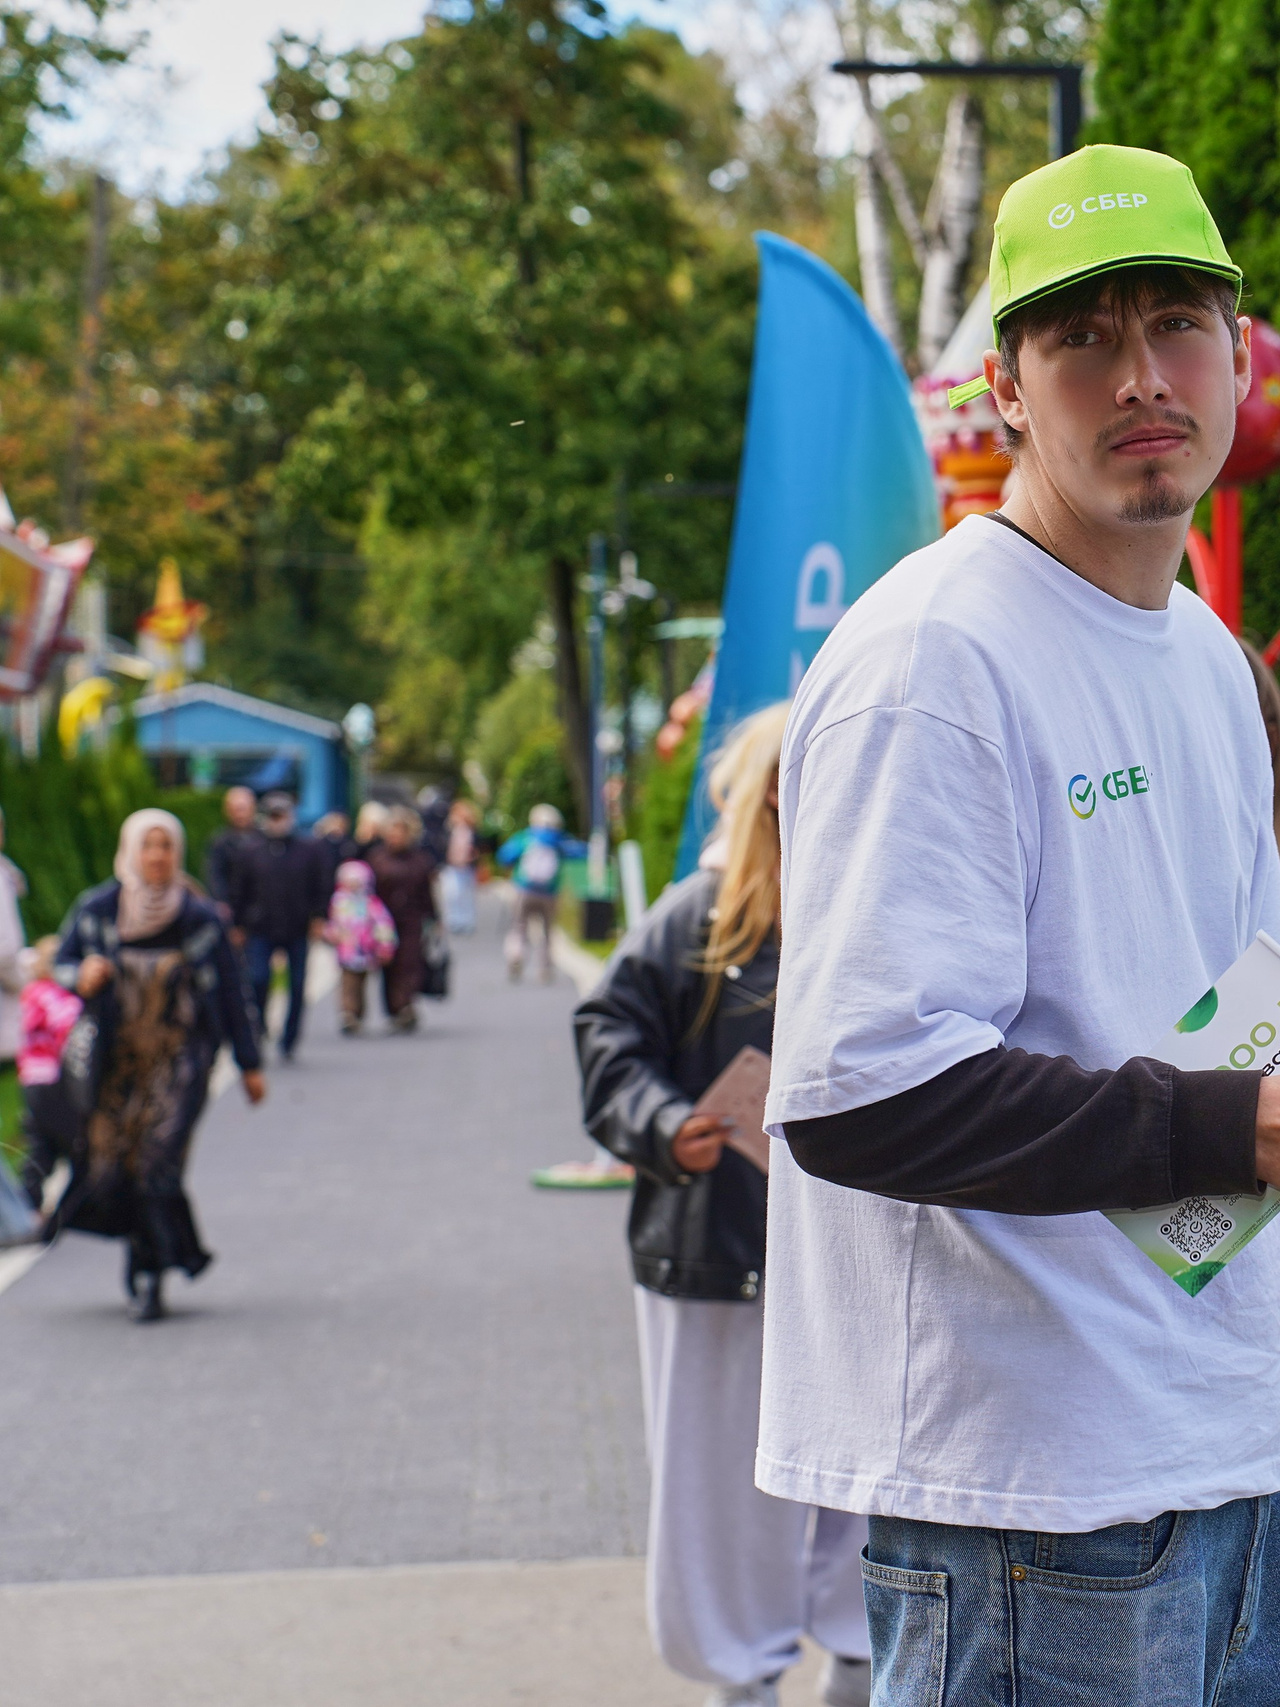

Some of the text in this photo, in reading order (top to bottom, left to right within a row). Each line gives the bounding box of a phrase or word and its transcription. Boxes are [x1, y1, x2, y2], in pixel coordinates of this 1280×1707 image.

[1081, 193, 1148, 213] СБЕР
[1102, 765, 1150, 801] СБЕ
[1214, 1021, 1277, 1070] 00
